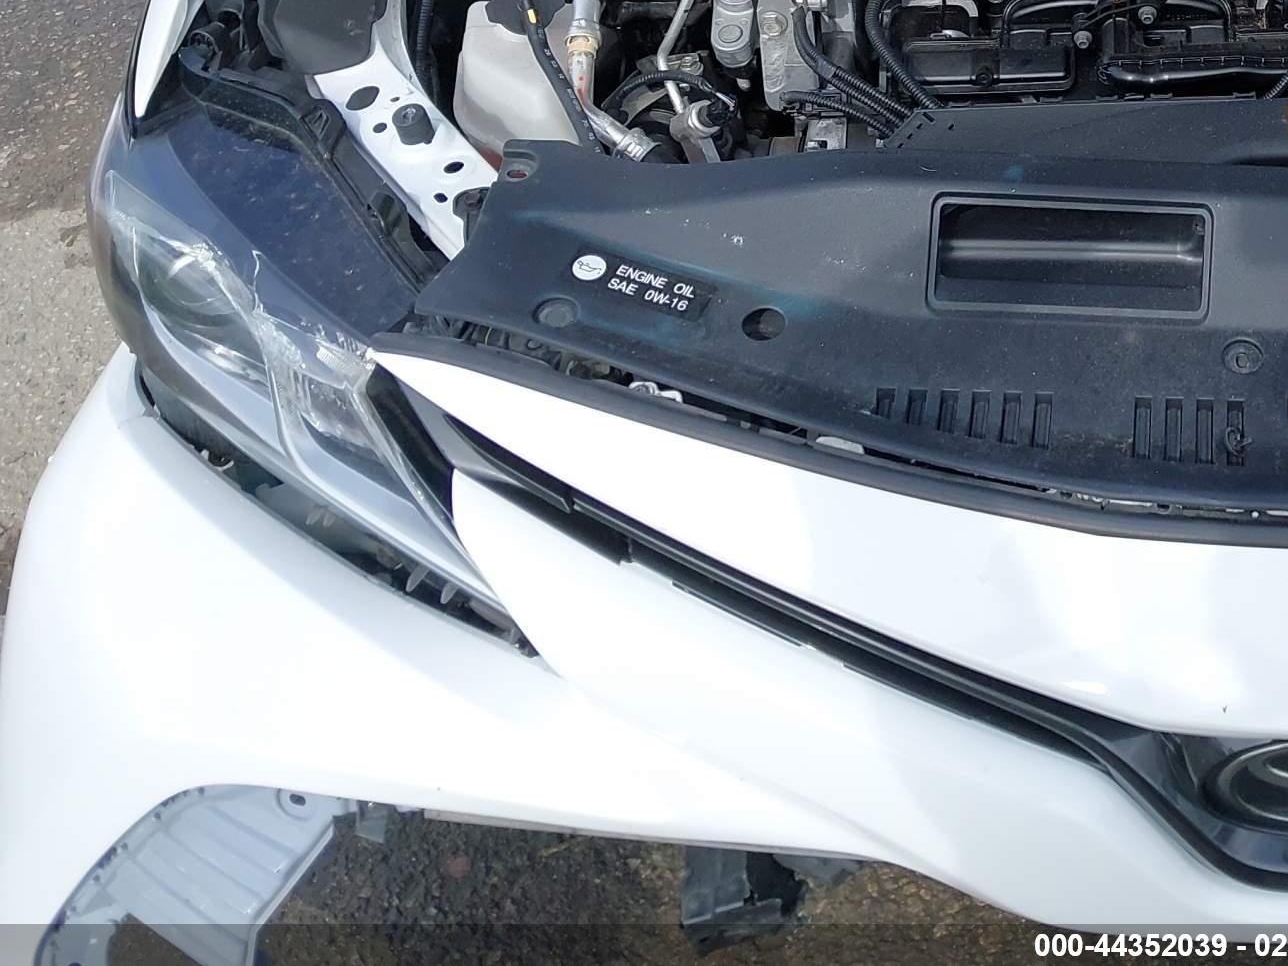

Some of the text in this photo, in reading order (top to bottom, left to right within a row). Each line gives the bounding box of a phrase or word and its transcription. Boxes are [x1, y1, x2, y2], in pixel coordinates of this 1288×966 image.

[608, 278, 688, 311] SAE 0W-16
[616, 265, 695, 298] ENGINE OIL
